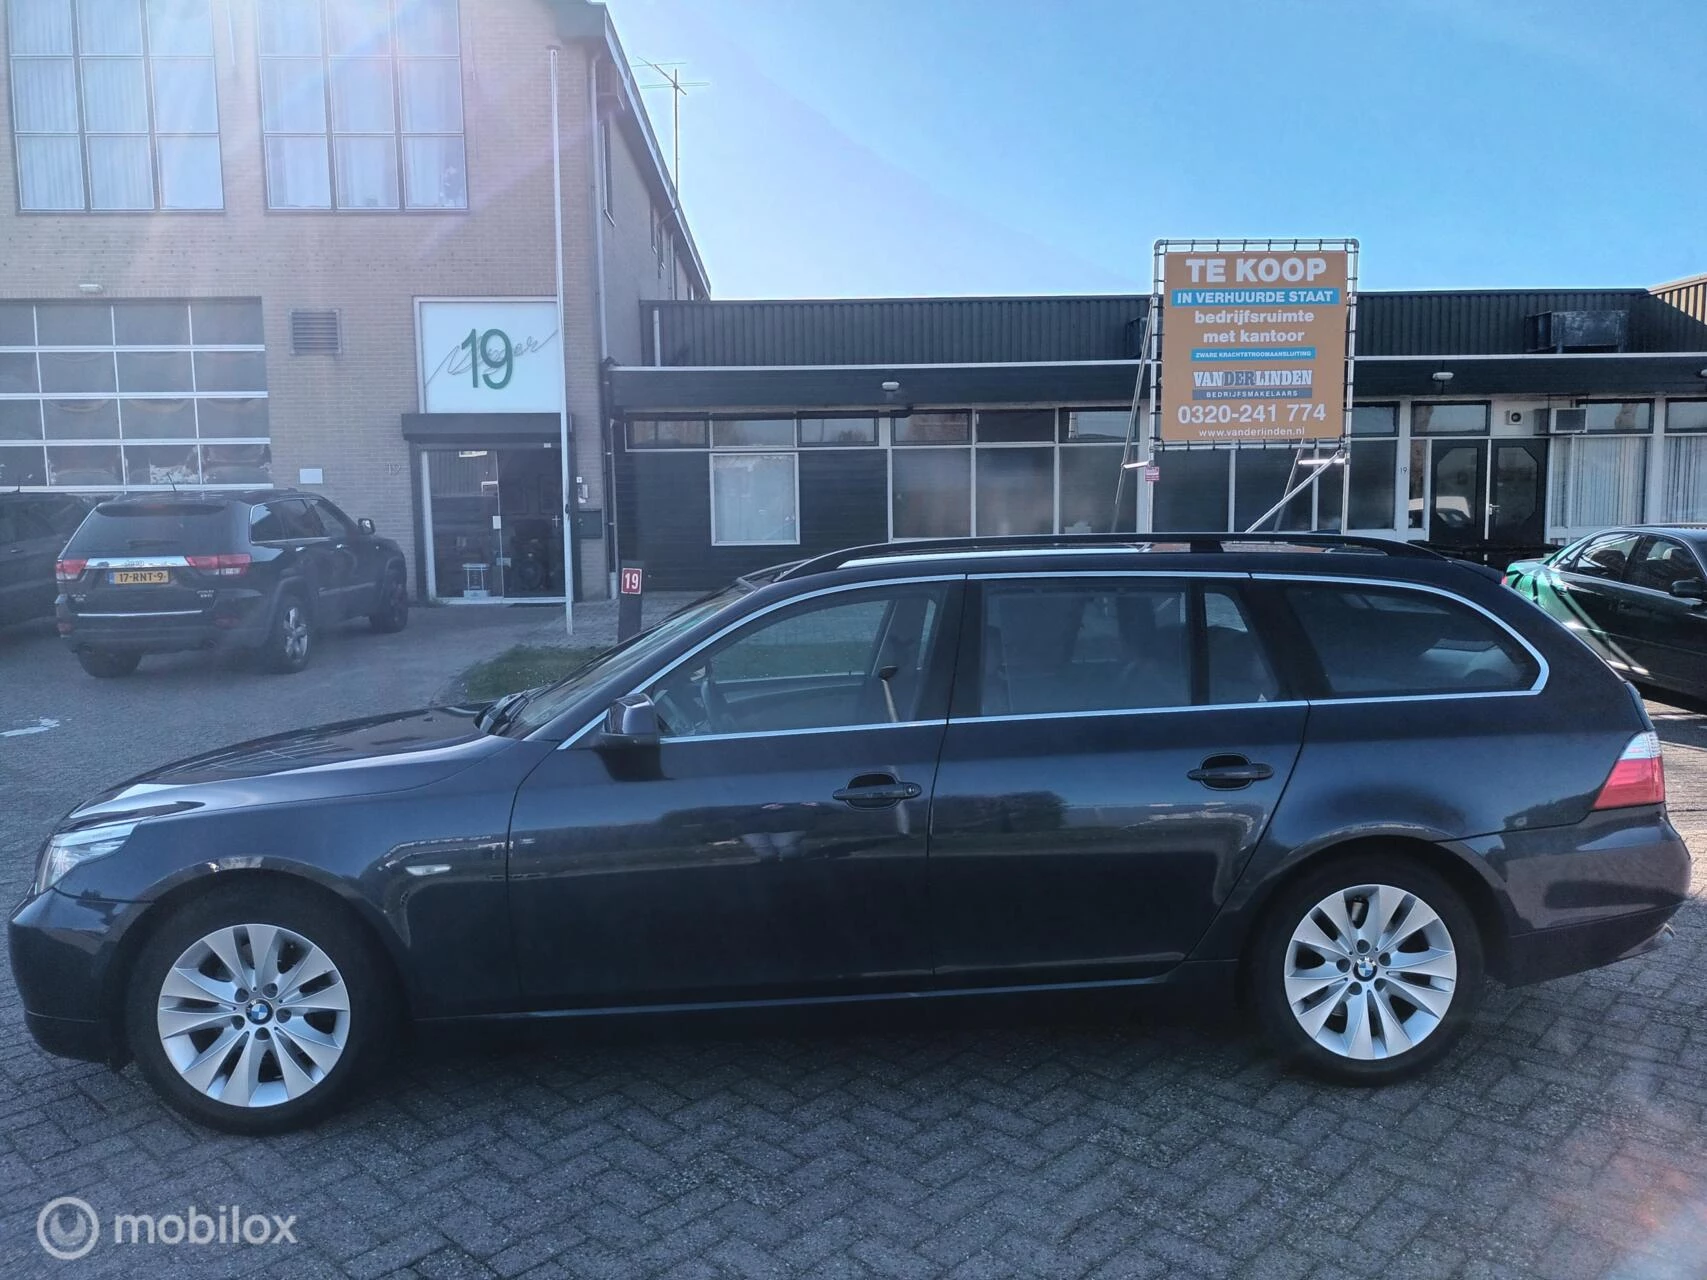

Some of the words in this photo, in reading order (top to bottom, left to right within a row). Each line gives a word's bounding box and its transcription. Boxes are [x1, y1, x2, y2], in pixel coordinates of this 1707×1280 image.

[1185, 259, 1226, 282] TE
[1236, 258, 1326, 282] KOOP
[1177, 293, 1193, 303] IN
[1196, 291, 1285, 303] VERHUURDE
[1289, 290, 1333, 302] STAAT
[1194, 310, 1315, 325] bedrijfsruimte
[1203, 331, 1236, 343] met
[1240, 329, 1305, 342] kantoor
[461, 328, 513, 390] 19
[1206, 390, 1298, 398] BEDRIJFSMAKELAARS
[1177, 404, 1277, 424] 0320-241
[1286, 403, 1327, 422] 774
[1199, 427, 1305, 437] www.vanderlinden.nl
[1400, 466, 1408, 474] 19
[119, 572, 164, 583] 17-RNT-9
[625, 572, 639, 590] 19
